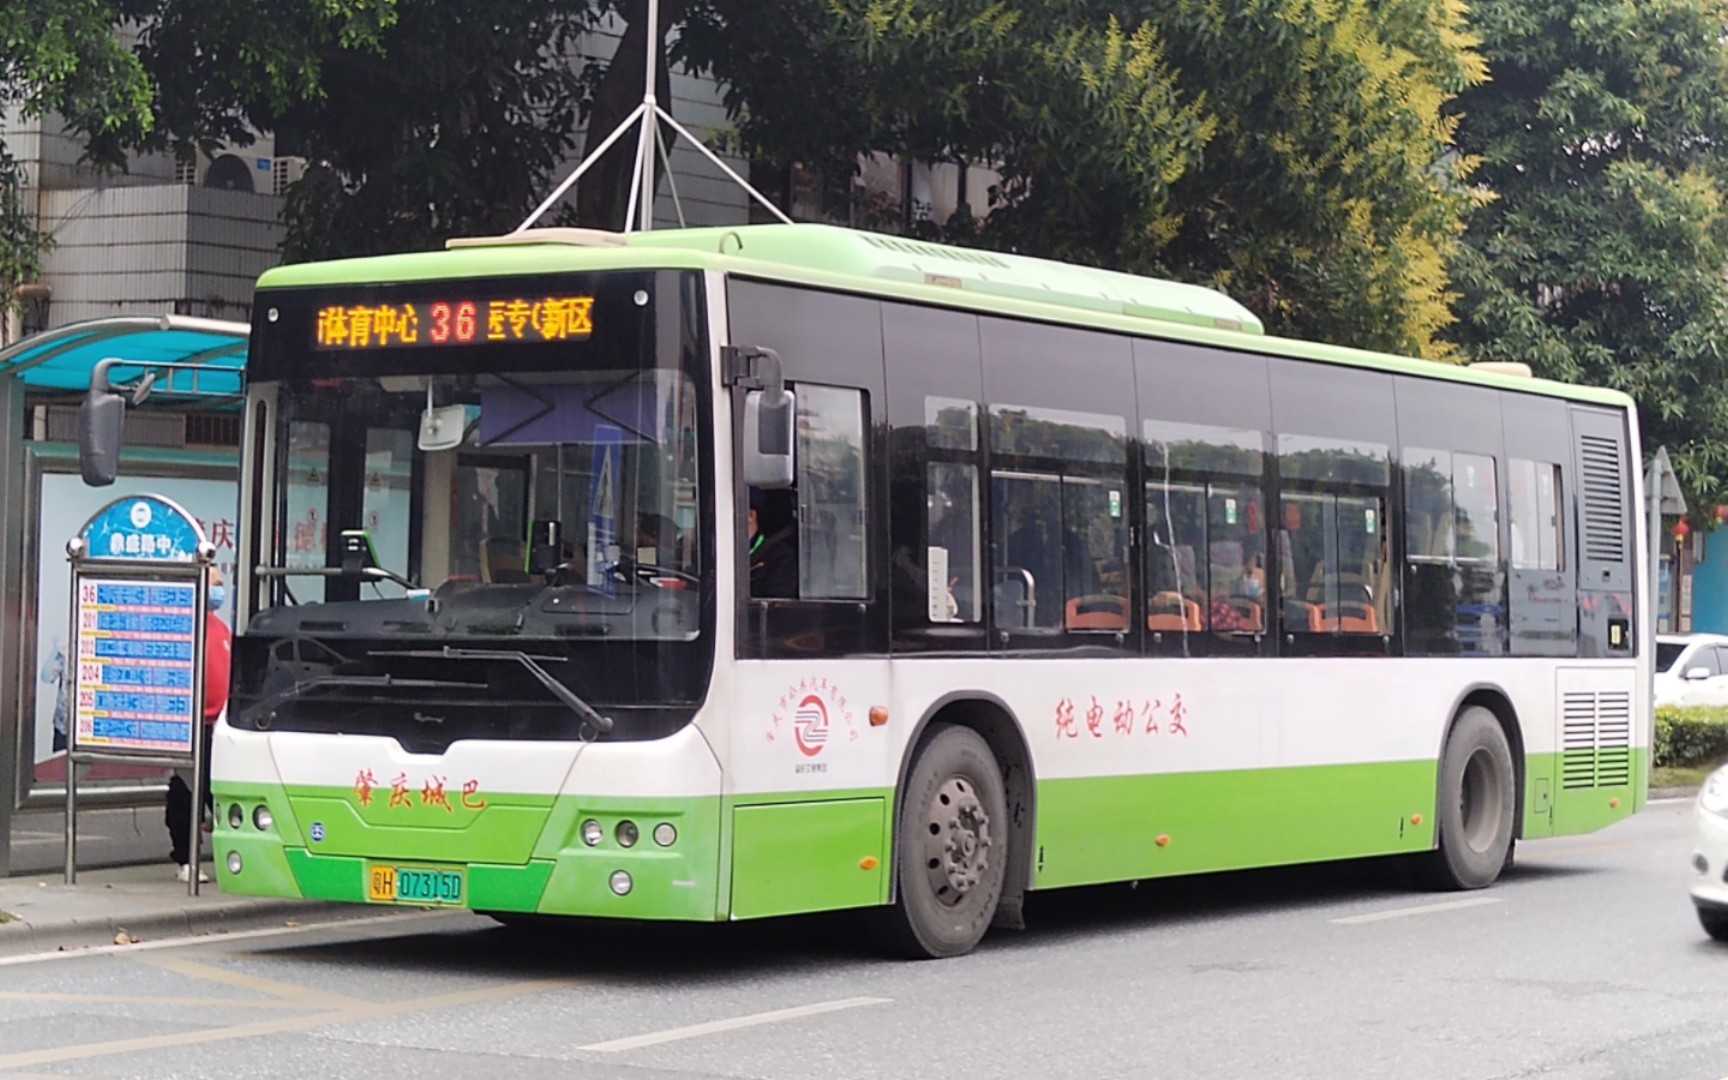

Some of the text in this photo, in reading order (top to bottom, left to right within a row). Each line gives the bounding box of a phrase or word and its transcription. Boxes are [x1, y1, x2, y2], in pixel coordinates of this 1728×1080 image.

[430, 301, 477, 342] 36
[82, 585, 96, 603] 36
[1055, 692, 1188, 740] 纯电动公交
[354, 767, 486, 812] 肇庆城巴
